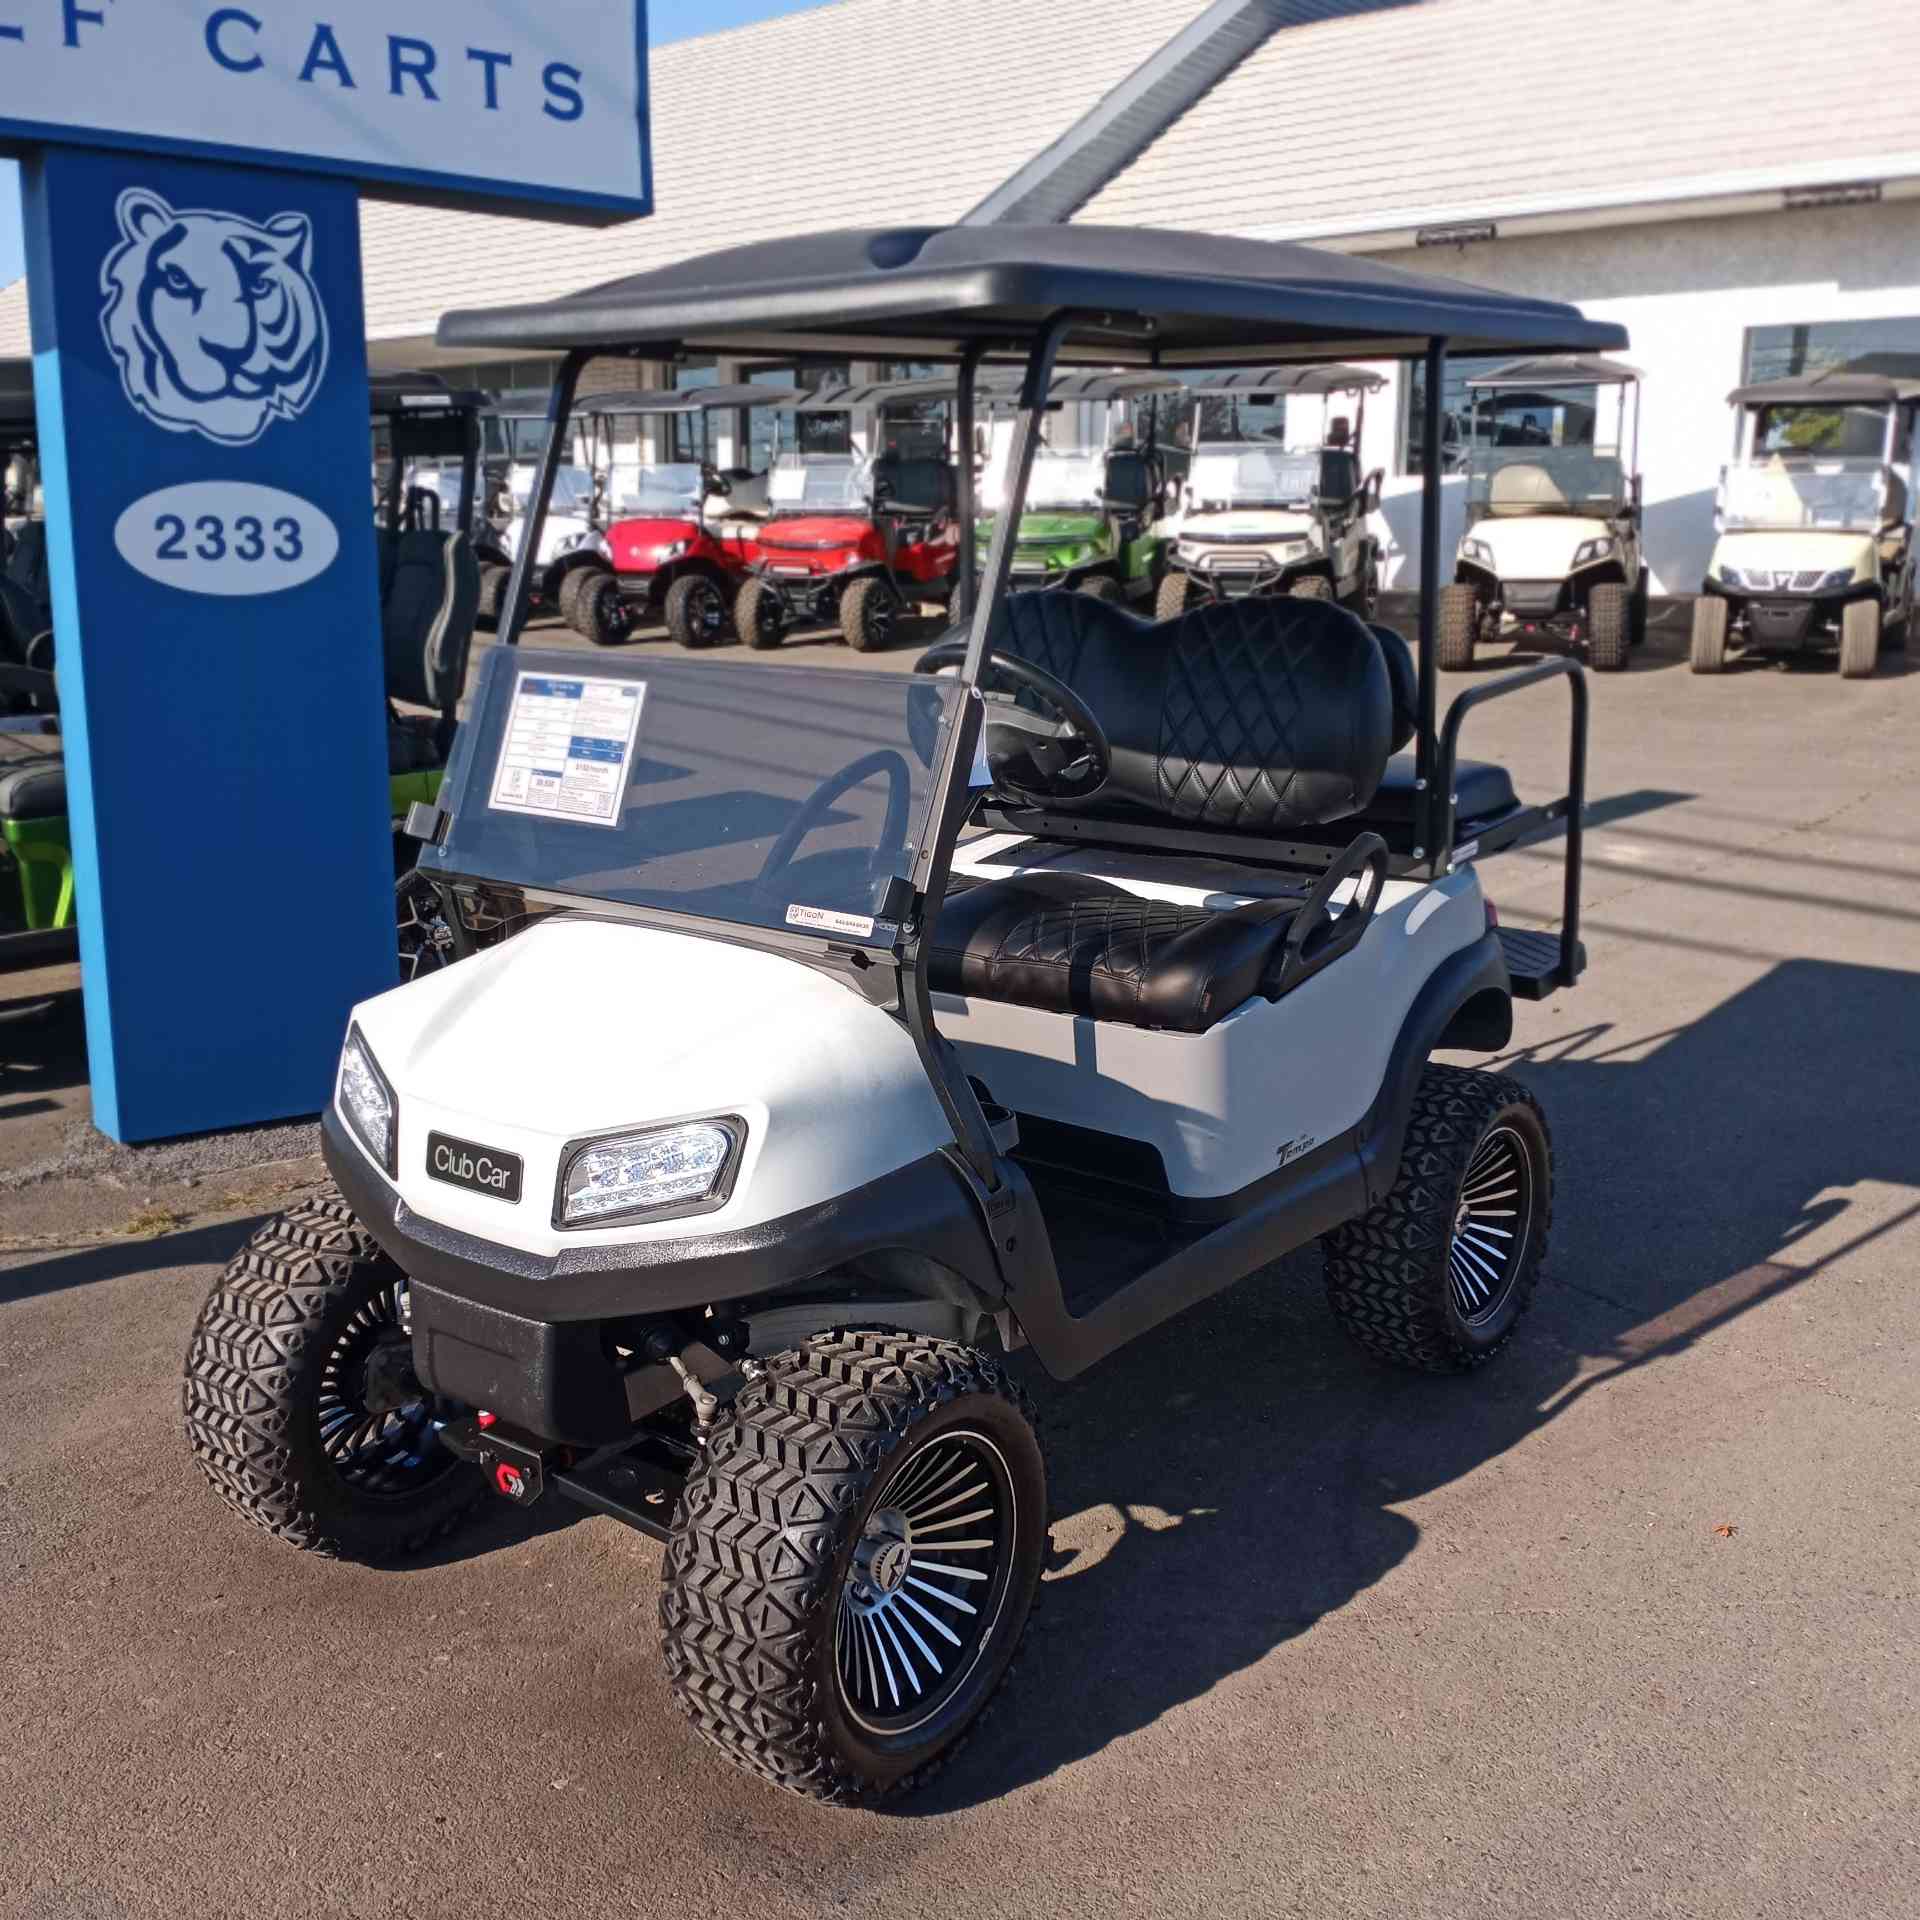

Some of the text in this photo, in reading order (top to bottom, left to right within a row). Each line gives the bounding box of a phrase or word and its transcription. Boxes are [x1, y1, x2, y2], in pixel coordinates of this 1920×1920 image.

[205, 8, 585, 122] CARTS
[154, 513, 304, 562] 2333
[435, 1144, 511, 1190] Club Car
